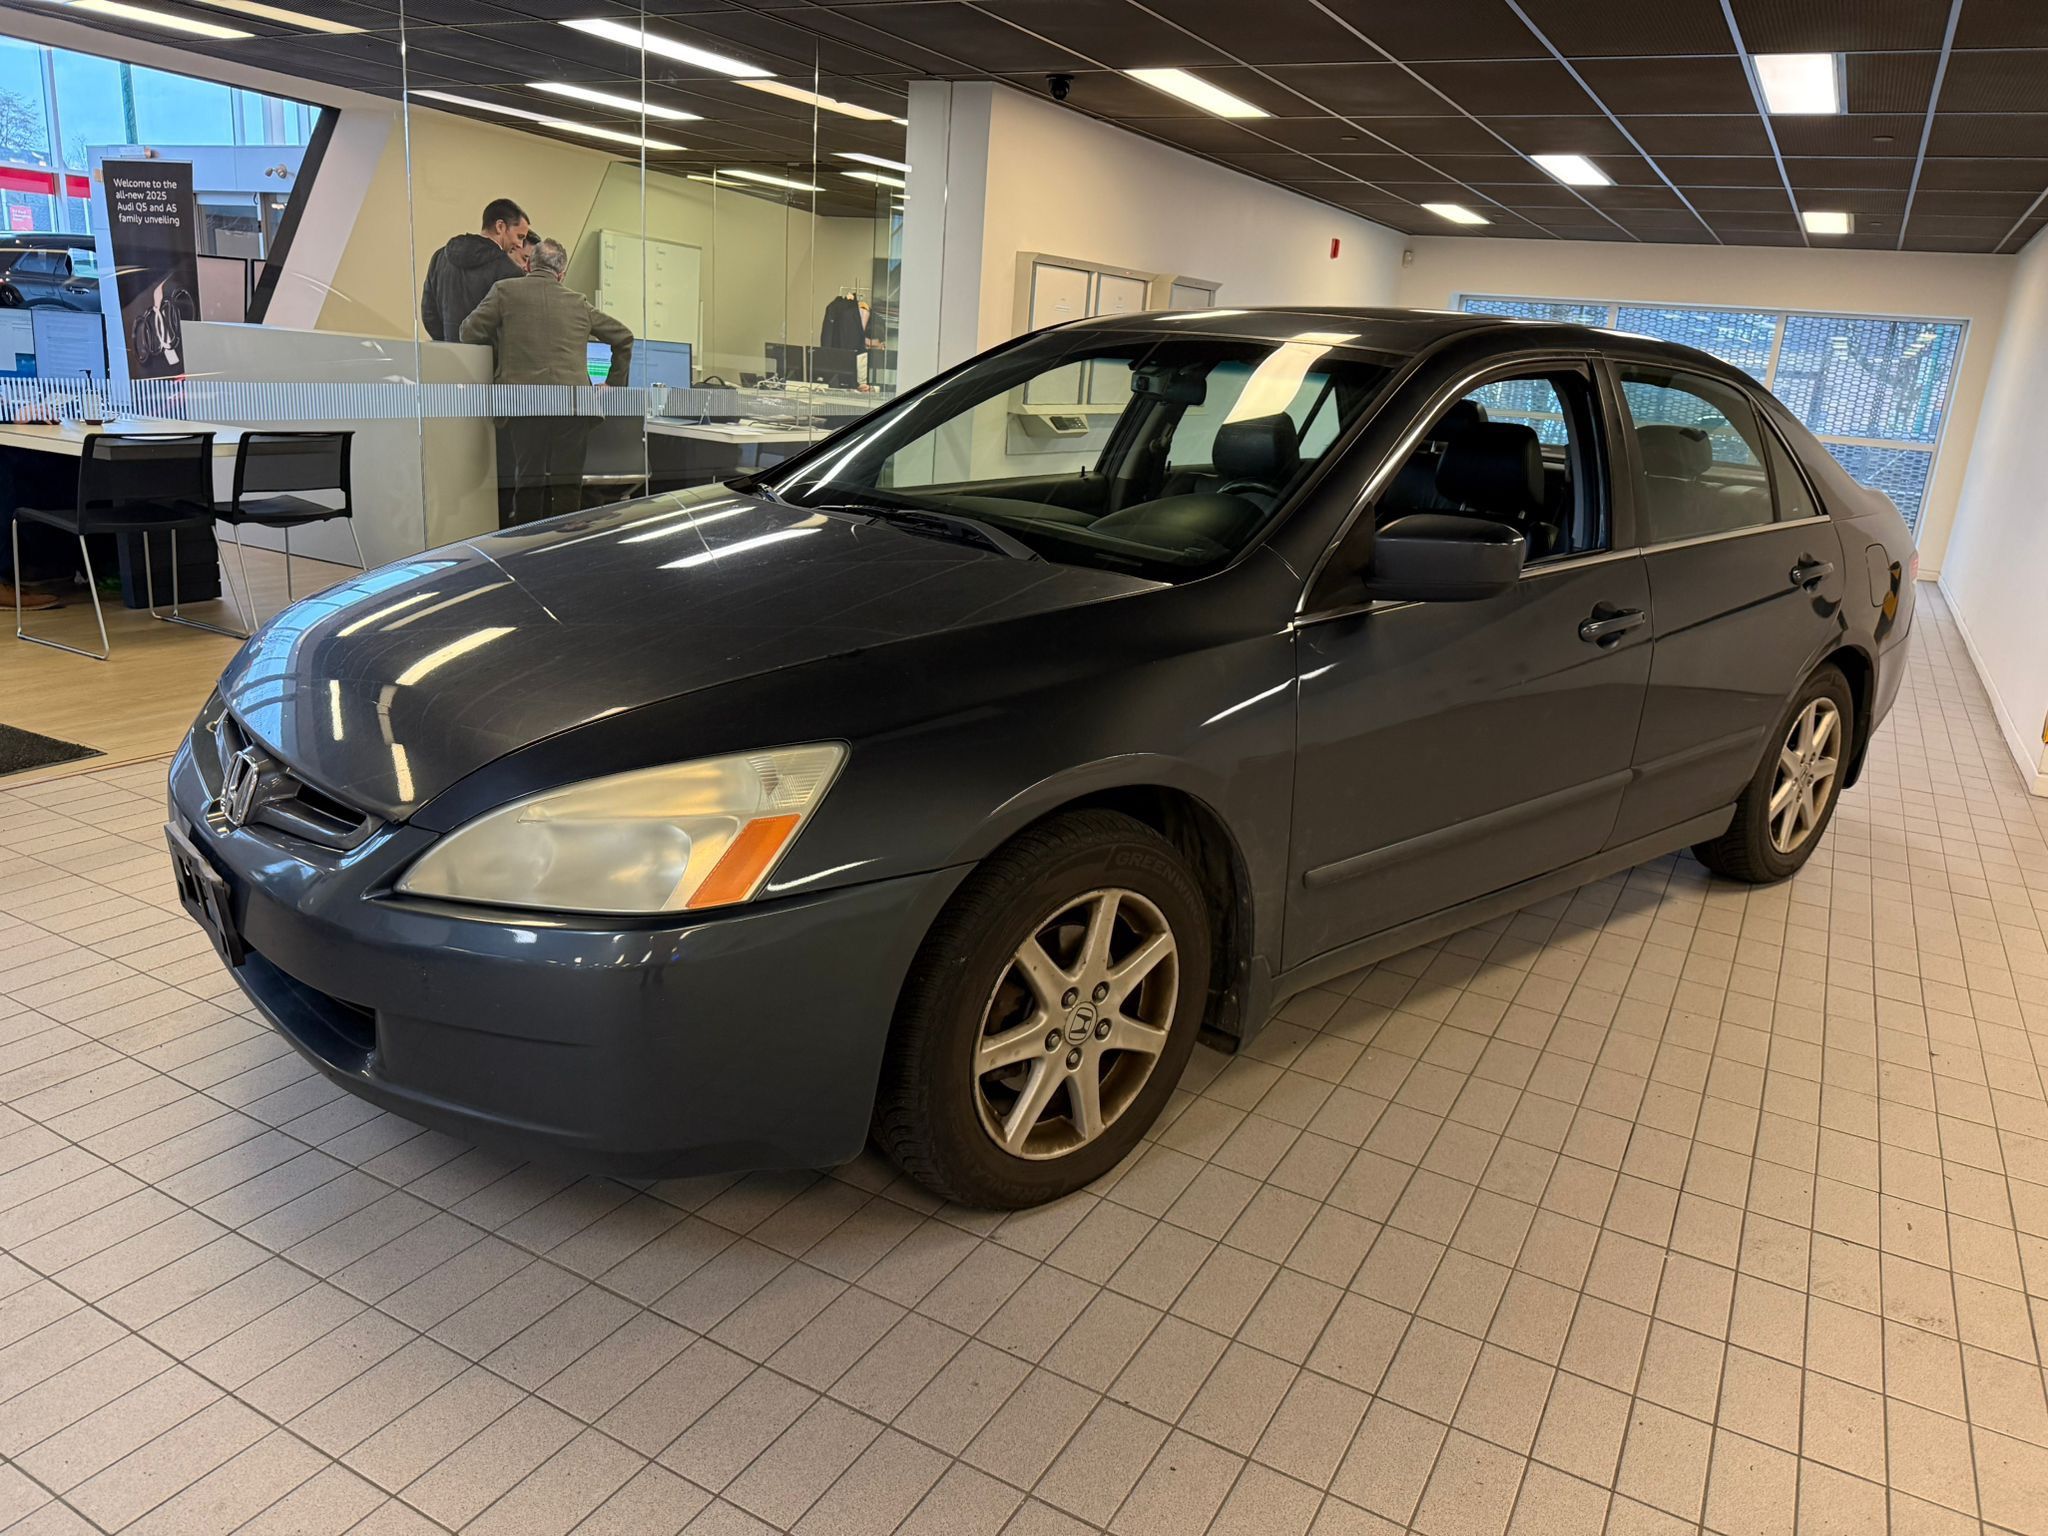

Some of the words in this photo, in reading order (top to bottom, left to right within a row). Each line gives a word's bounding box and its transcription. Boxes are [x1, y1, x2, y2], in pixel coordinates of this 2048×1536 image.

[113, 178, 151, 188] Welcome
[152, 180, 162, 189] to
[163, 179, 177, 189] the
[115, 190, 144, 199] all-new
[146, 191, 167, 200] 2025
[117, 202, 134, 211] Audi
[135, 202, 148, 212] Q5
[149, 203, 164, 212] and
[166, 203, 178, 213] A5
[118, 213, 143, 225] family
[144, 215, 180, 227] unveiling
